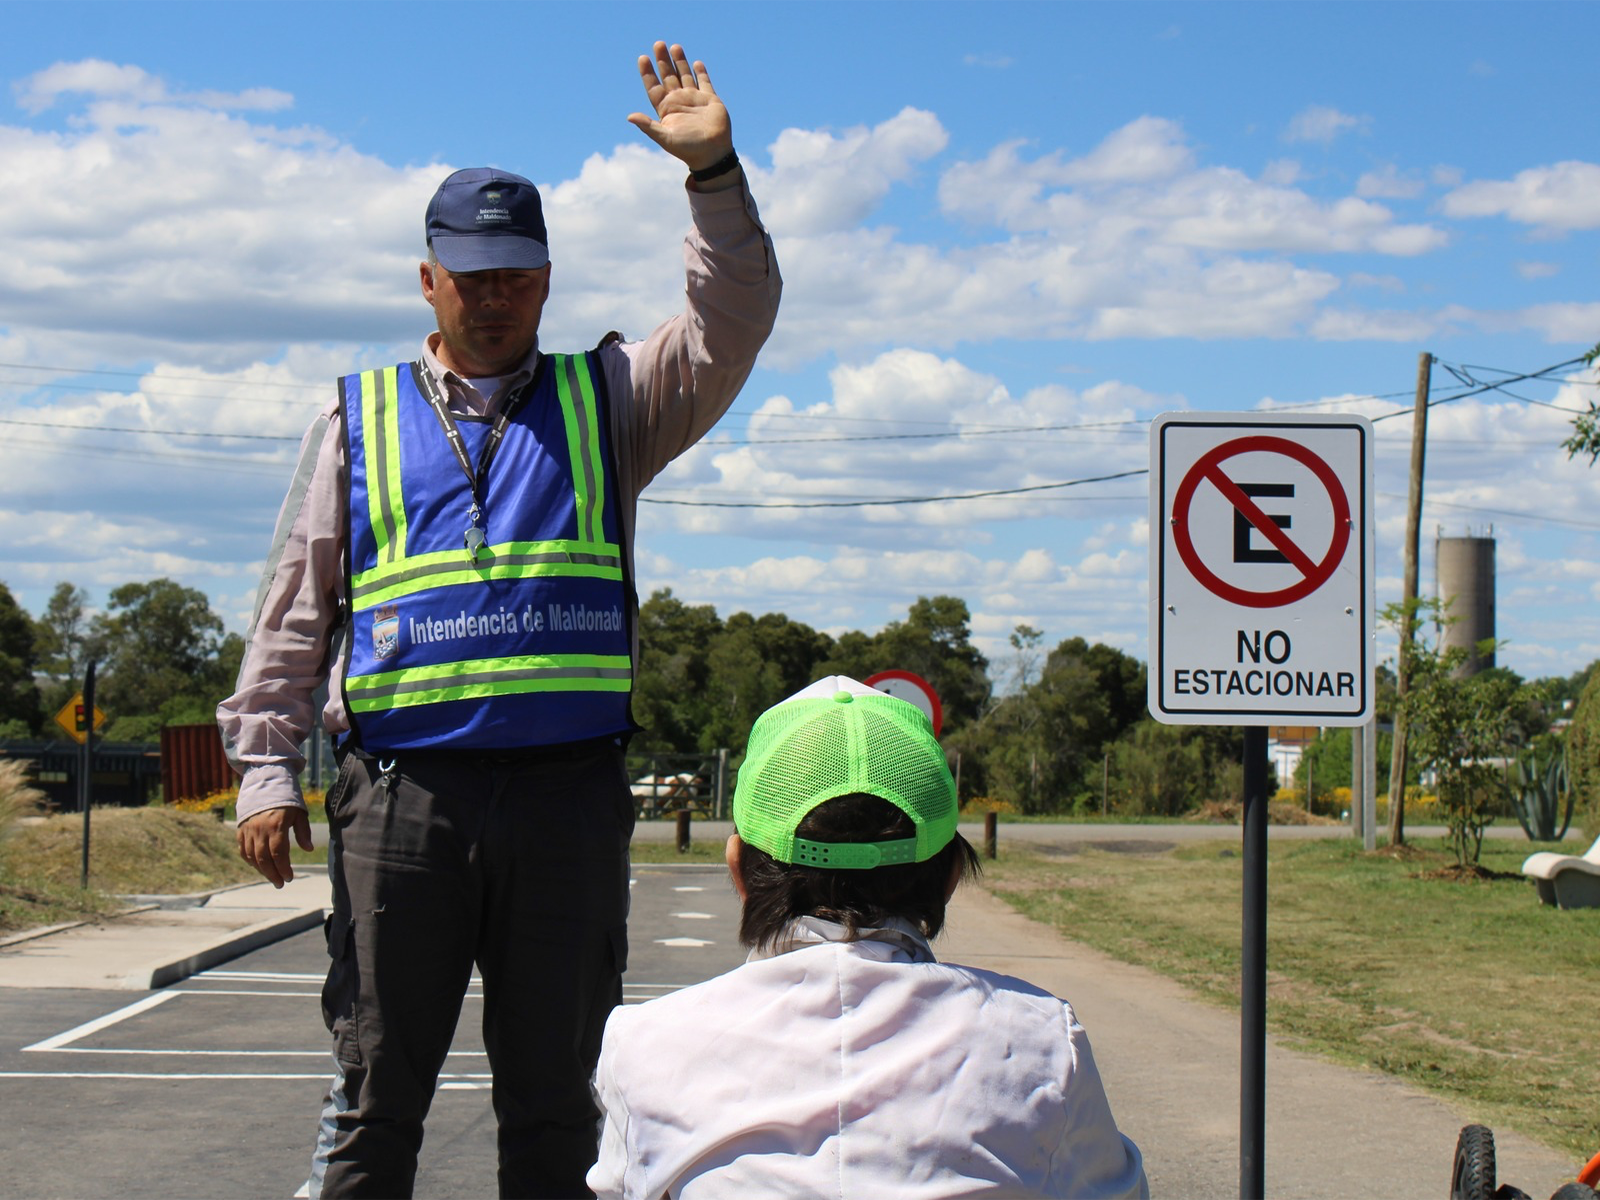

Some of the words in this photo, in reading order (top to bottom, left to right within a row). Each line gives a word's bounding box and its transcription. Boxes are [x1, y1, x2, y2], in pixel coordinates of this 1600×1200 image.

[1234, 484, 1294, 563] E
[409, 607, 517, 644] Intendencia
[523, 604, 544, 632] de
[1237, 630, 1292, 664] NO
[1174, 670, 1354, 697] ESTACIONAR
